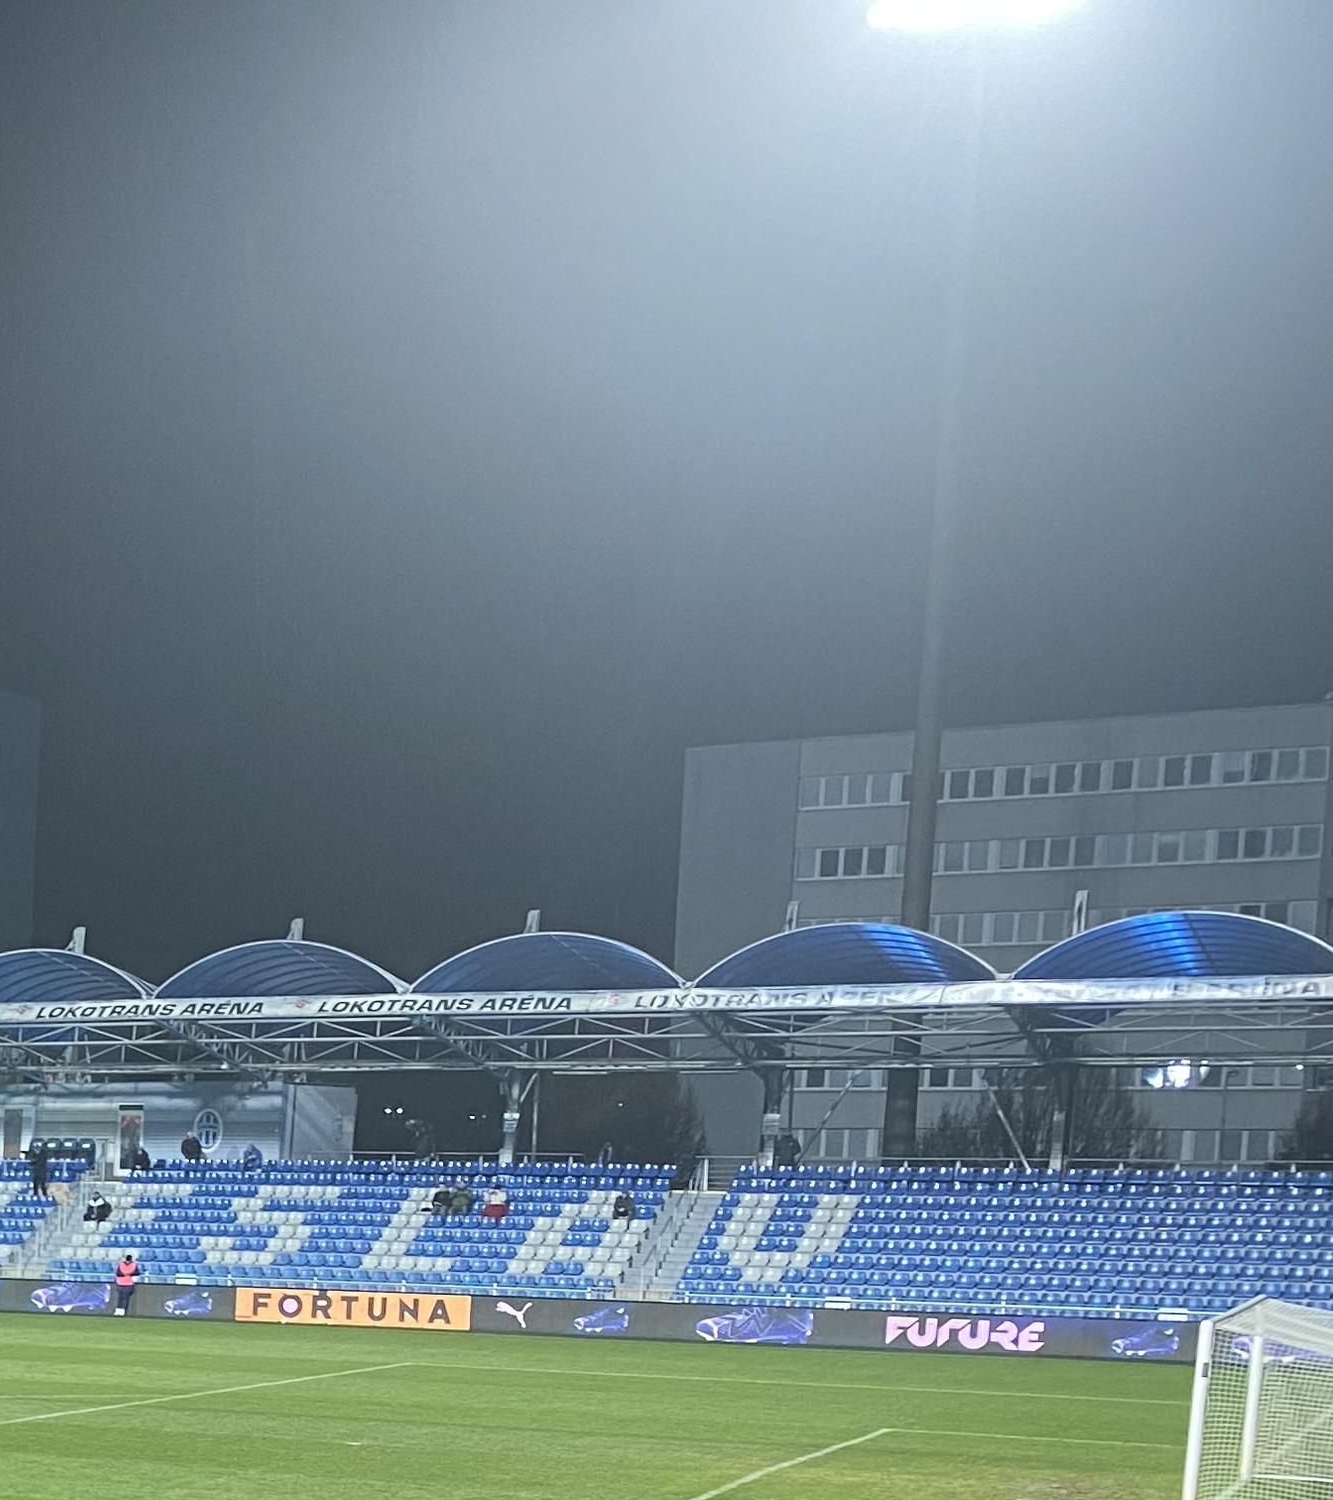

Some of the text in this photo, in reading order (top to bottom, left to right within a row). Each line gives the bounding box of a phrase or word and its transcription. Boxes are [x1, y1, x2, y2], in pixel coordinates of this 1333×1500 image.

[35, 1003, 177, 1019] LOKOTRANS
[316, 998, 472, 1014] LOKOTRANS
[251, 1292, 452, 1325] FORTUNA
[885, 1316, 1045, 1352] FUTURE
